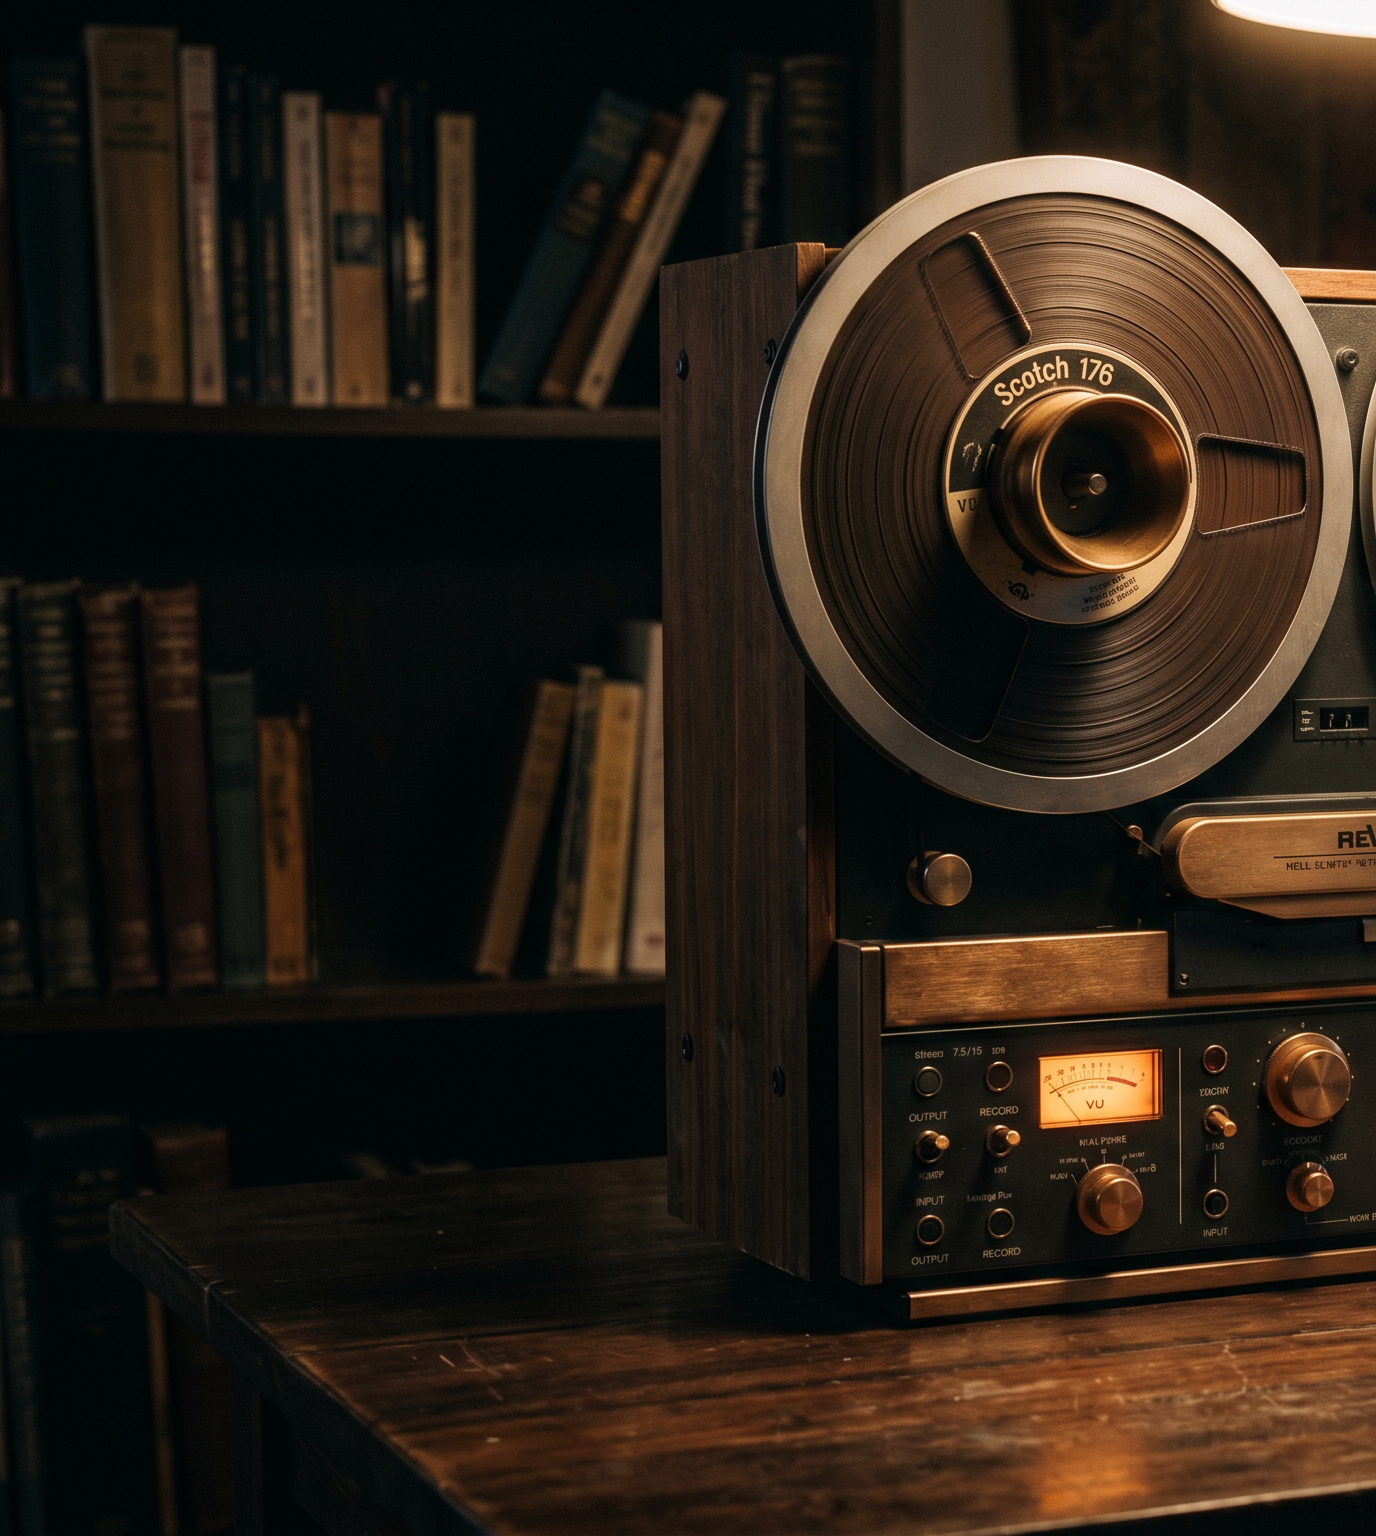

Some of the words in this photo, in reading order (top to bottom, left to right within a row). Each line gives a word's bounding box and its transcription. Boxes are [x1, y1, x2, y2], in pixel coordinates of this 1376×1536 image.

[994, 355, 1069, 406] Scotch
[1080, 357, 1115, 386] 176
[952, 1046, 983, 1057] 7.5/15
[1085, 1099, 1105, 1110] VU
[908, 1111, 948, 1122] OUTPUT
[979, 1105, 1019, 1117] RECORD
[915, 1195, 945, 1207] INPUT
[1203, 1227, 1228, 1238] INPUT
[982, 1246, 1021, 1259] RECORD
[911, 1253, 949, 1266] OUTPUT
